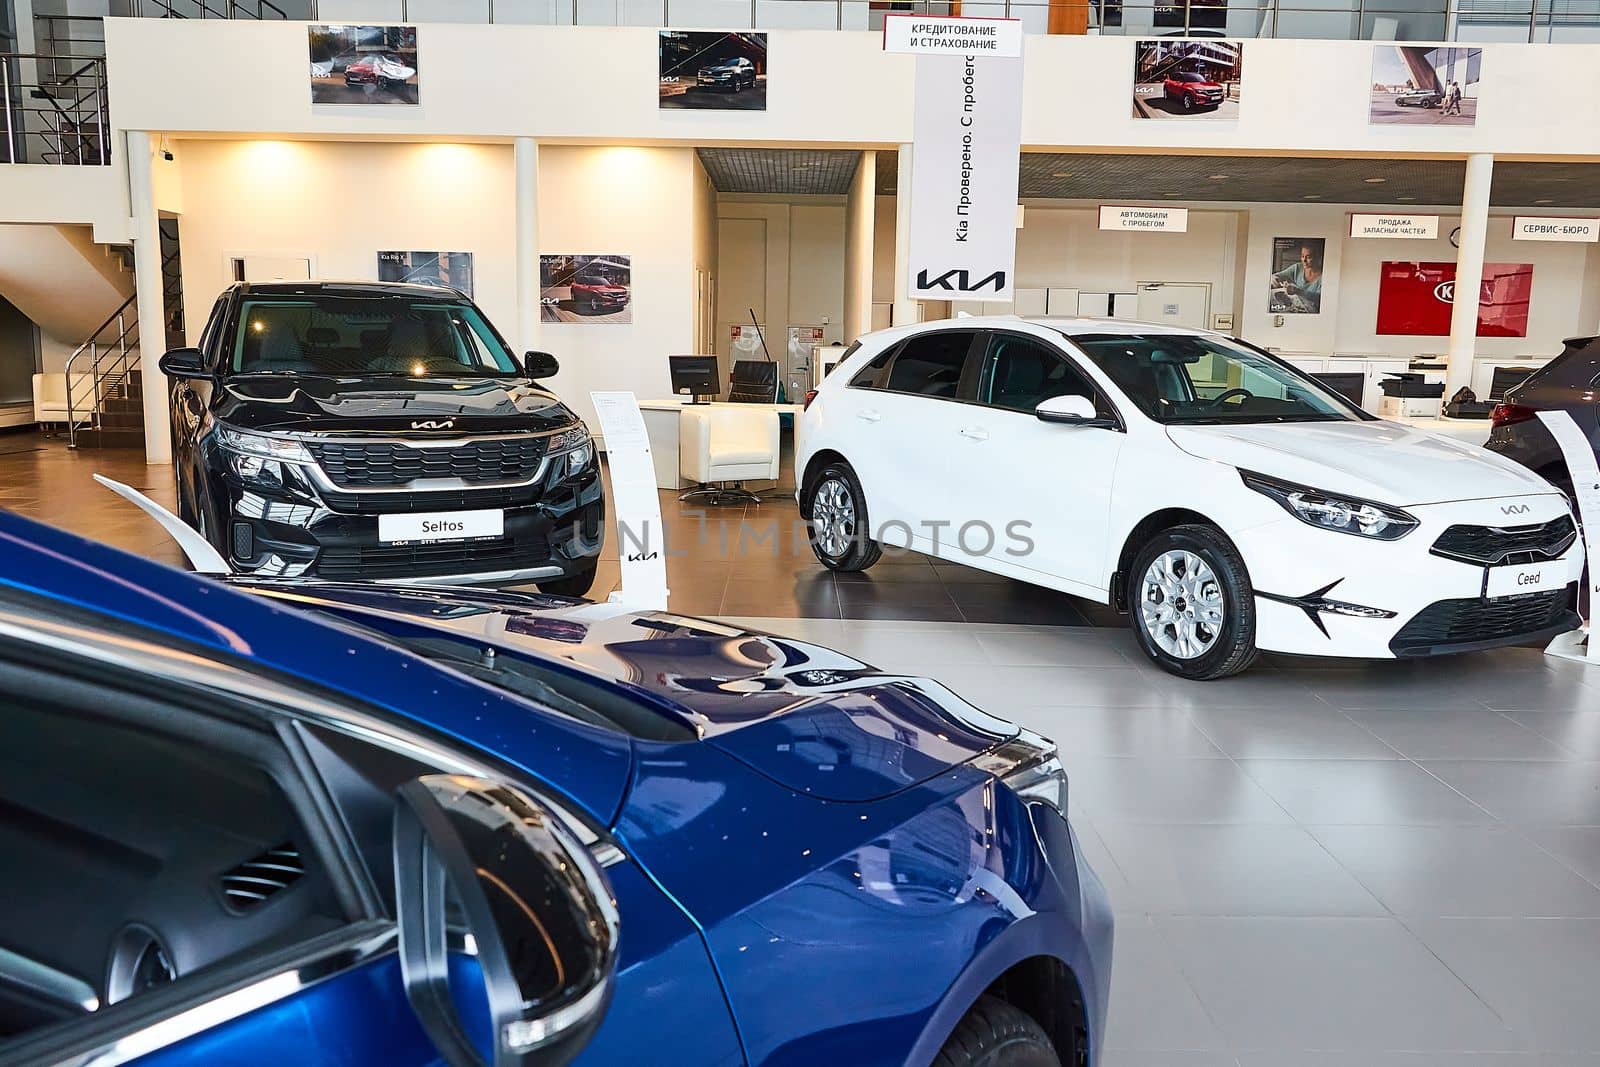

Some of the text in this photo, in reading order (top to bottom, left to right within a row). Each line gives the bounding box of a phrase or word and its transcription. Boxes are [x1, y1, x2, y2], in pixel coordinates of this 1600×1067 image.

[911, 24, 997, 36] КРЕДИТОВАНИЕ
[910, 38, 997, 50] И СТРАХОВАНИЕ
[957, 132, 973, 215] Проверено.
[956, 220, 968, 242] Kia
[1523, 224, 1589, 234] СЕРВИС-БЮРО
[917, 269, 1006, 292] KIA
[422, 521, 464, 532] Seltos
[1517, 571, 1541, 586] Ceed
